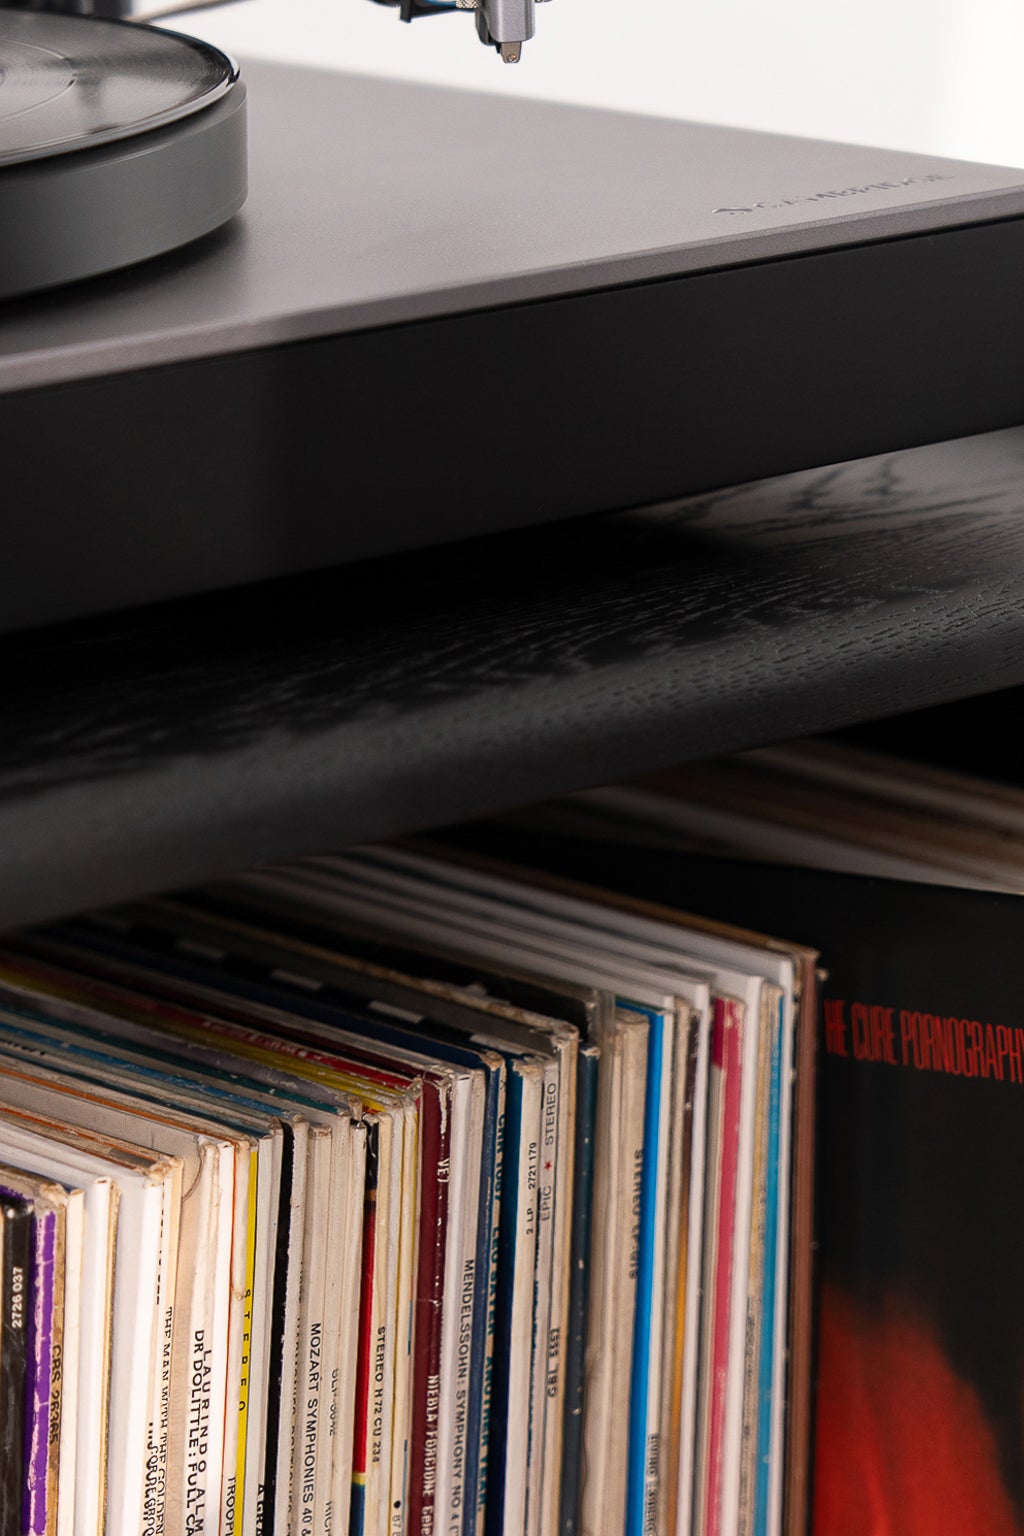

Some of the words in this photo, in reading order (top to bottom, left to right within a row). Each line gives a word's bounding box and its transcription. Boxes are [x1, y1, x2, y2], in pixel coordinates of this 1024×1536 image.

[824, 999, 848, 1057] HE
[851, 1001, 898, 1066] CURE
[545, 1081, 557, 1146] STEREO
[528, 1163, 537, 1189] 2721
[527, 1207, 535, 1222] LP
[540, 1184, 552, 1220] EPIC
[526, 1227, 534, 1235] 2
[12, 1266, 24, 1292] 037
[11, 1293, 23, 1329] 2726
[193, 1329, 205, 1354] DR
[307, 1321, 321, 1392] MOZART
[374, 1325, 386, 1382] STEREO
[162, 1343, 171, 1382] MAN
[198, 1349, 212, 1473] LAURINDO
[303, 1398, 319, 1503] SYMPHONIES
[453, 1389, 466, 1480] SYMPHONY
[186, 1462, 199, 1509] FULL
[452, 1484, 462, 1508] NO
[302, 1506, 313, 1524] 40
